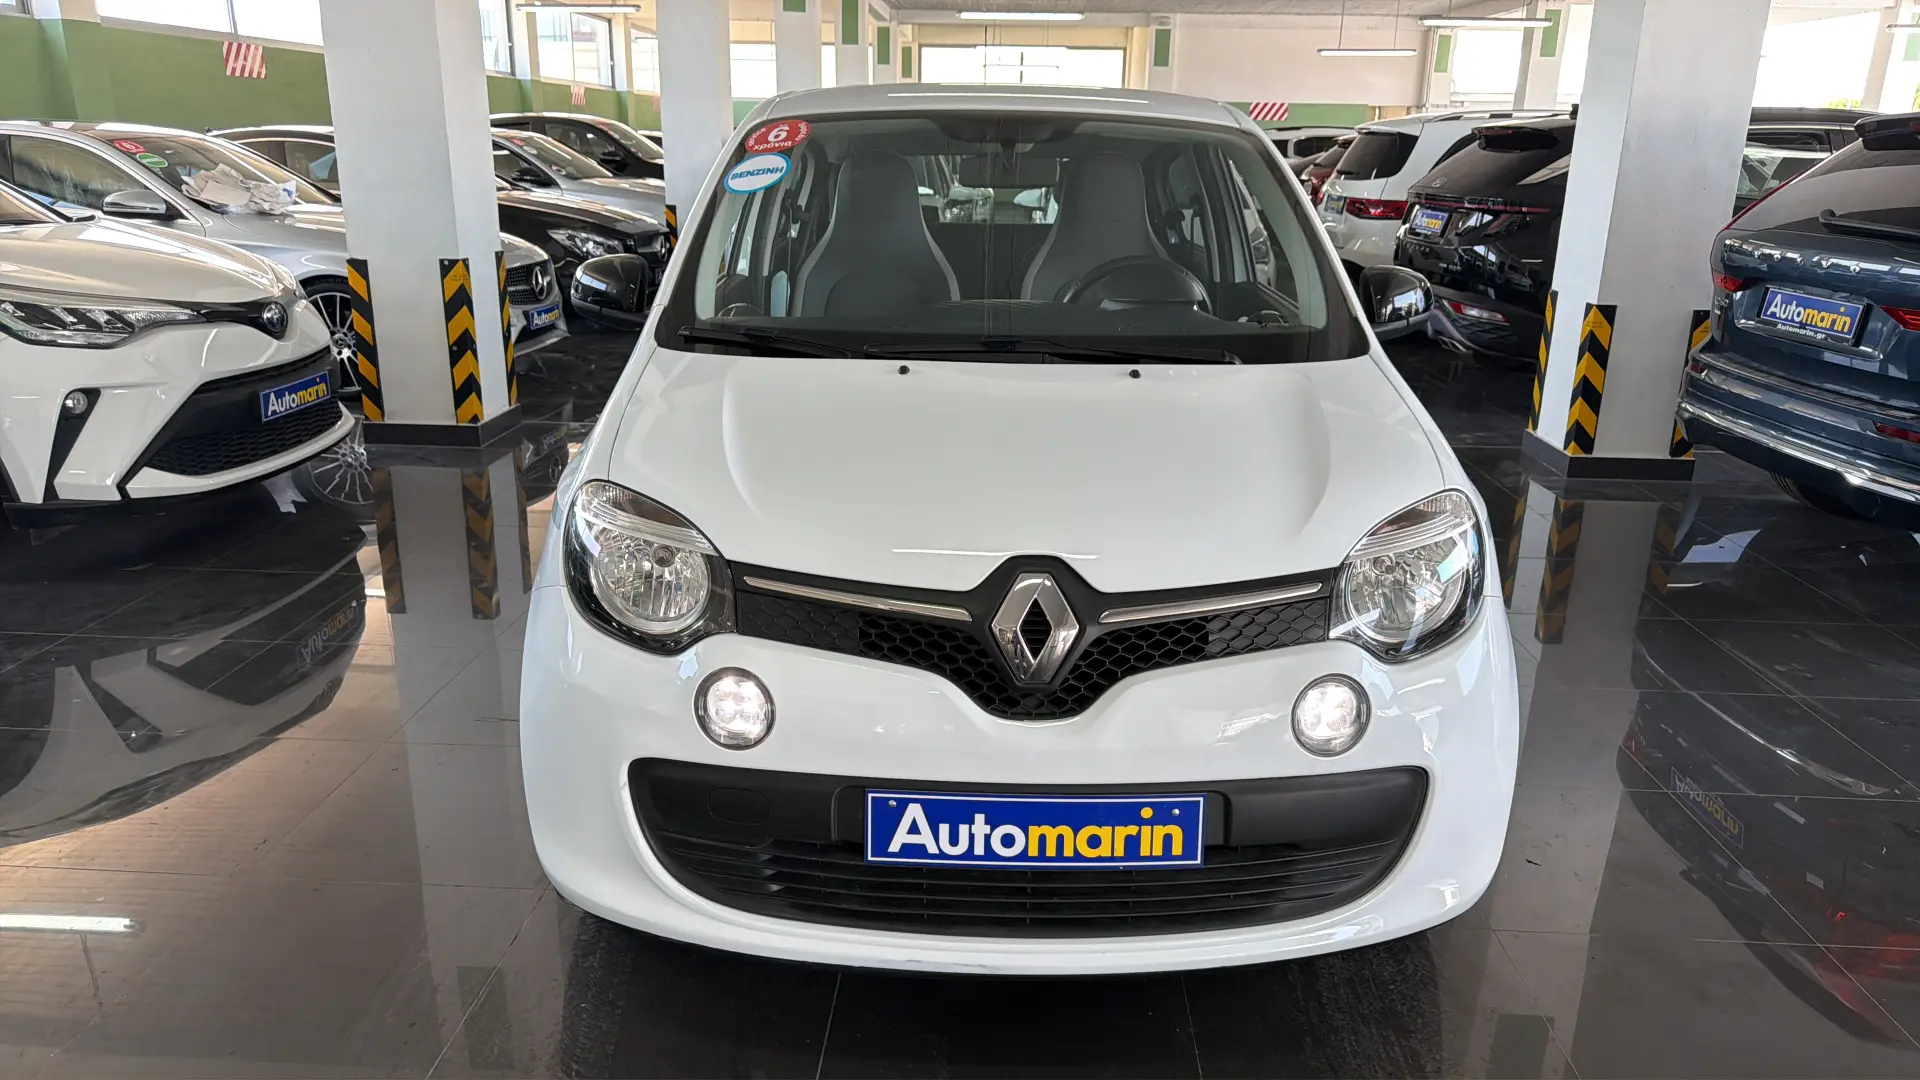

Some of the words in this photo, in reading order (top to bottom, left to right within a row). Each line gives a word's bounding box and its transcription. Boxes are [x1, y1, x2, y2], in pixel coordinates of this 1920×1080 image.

[752, 141, 792, 151] χρόνια
[767, 126, 790, 142] 6
[1767, 293, 1852, 333] Automarin
[1776, 323, 1827, 340] Automarin.gr
[267, 376, 328, 417] Automarin
[887, 802, 1184, 858] Automarin
